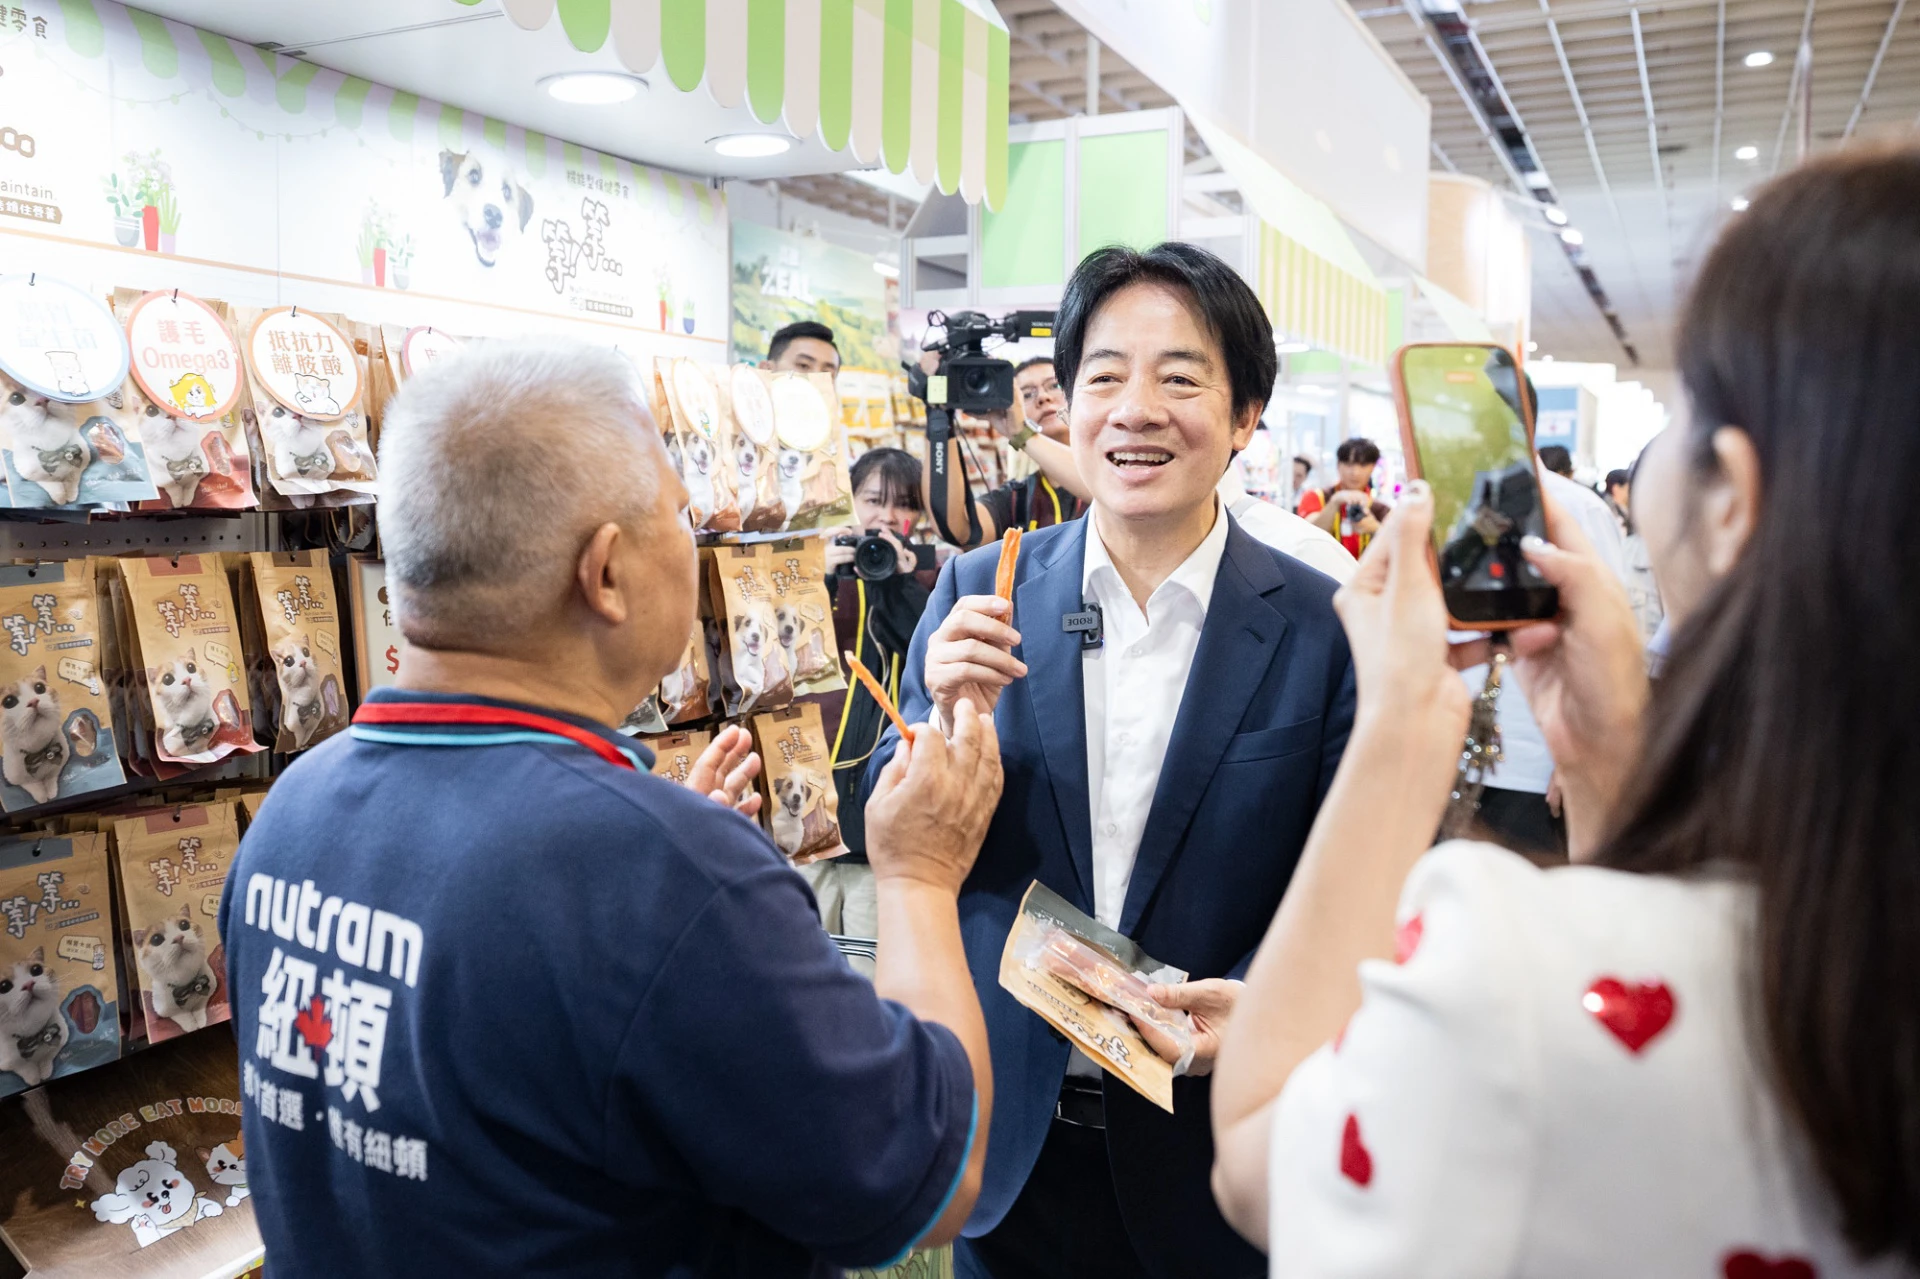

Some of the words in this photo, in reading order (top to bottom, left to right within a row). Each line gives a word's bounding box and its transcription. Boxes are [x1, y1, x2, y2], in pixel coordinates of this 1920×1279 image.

[760, 264, 815, 305] ZEAL
[158, 319, 206, 345] 護毛
[268, 330, 334, 353] 抵抗力
[143, 347, 230, 373] Omega3
[271, 353, 344, 376] 離胺酸
[935, 442, 944, 475] SONY
[385, 644, 400, 675] $
[245, 872, 424, 989] nutram
[256, 946, 393, 1113] 紐頓
[59, 1151, 93, 1190] TRY
[82, 1112, 141, 1156] MORE
[139, 1099, 183, 1122] EAT
